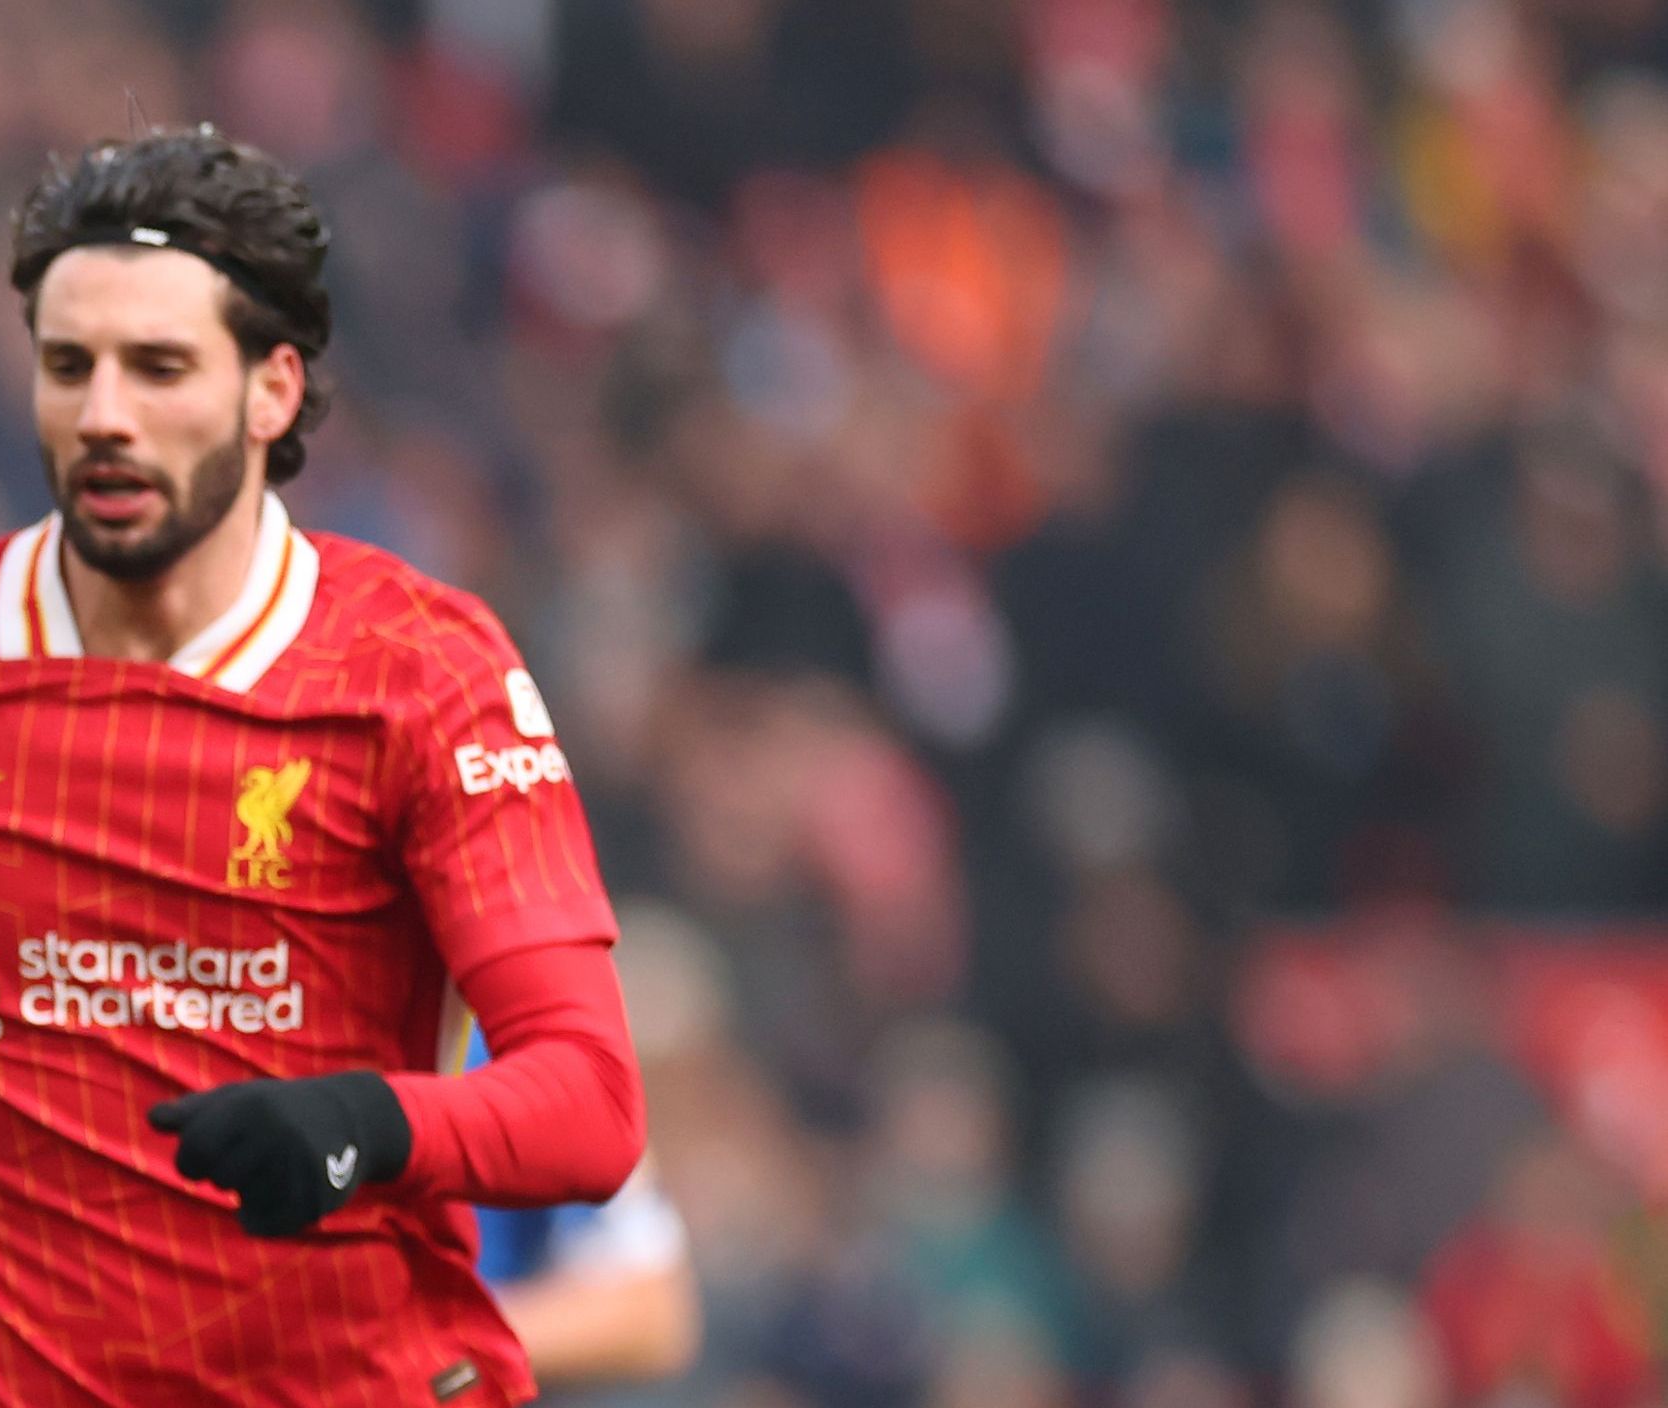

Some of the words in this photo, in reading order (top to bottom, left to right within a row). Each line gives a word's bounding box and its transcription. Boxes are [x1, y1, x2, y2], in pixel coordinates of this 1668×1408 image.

[454, 743, 571, 795] Expe
[17, 931, 289, 988] standard
[19, 979, 304, 1033] chartered
